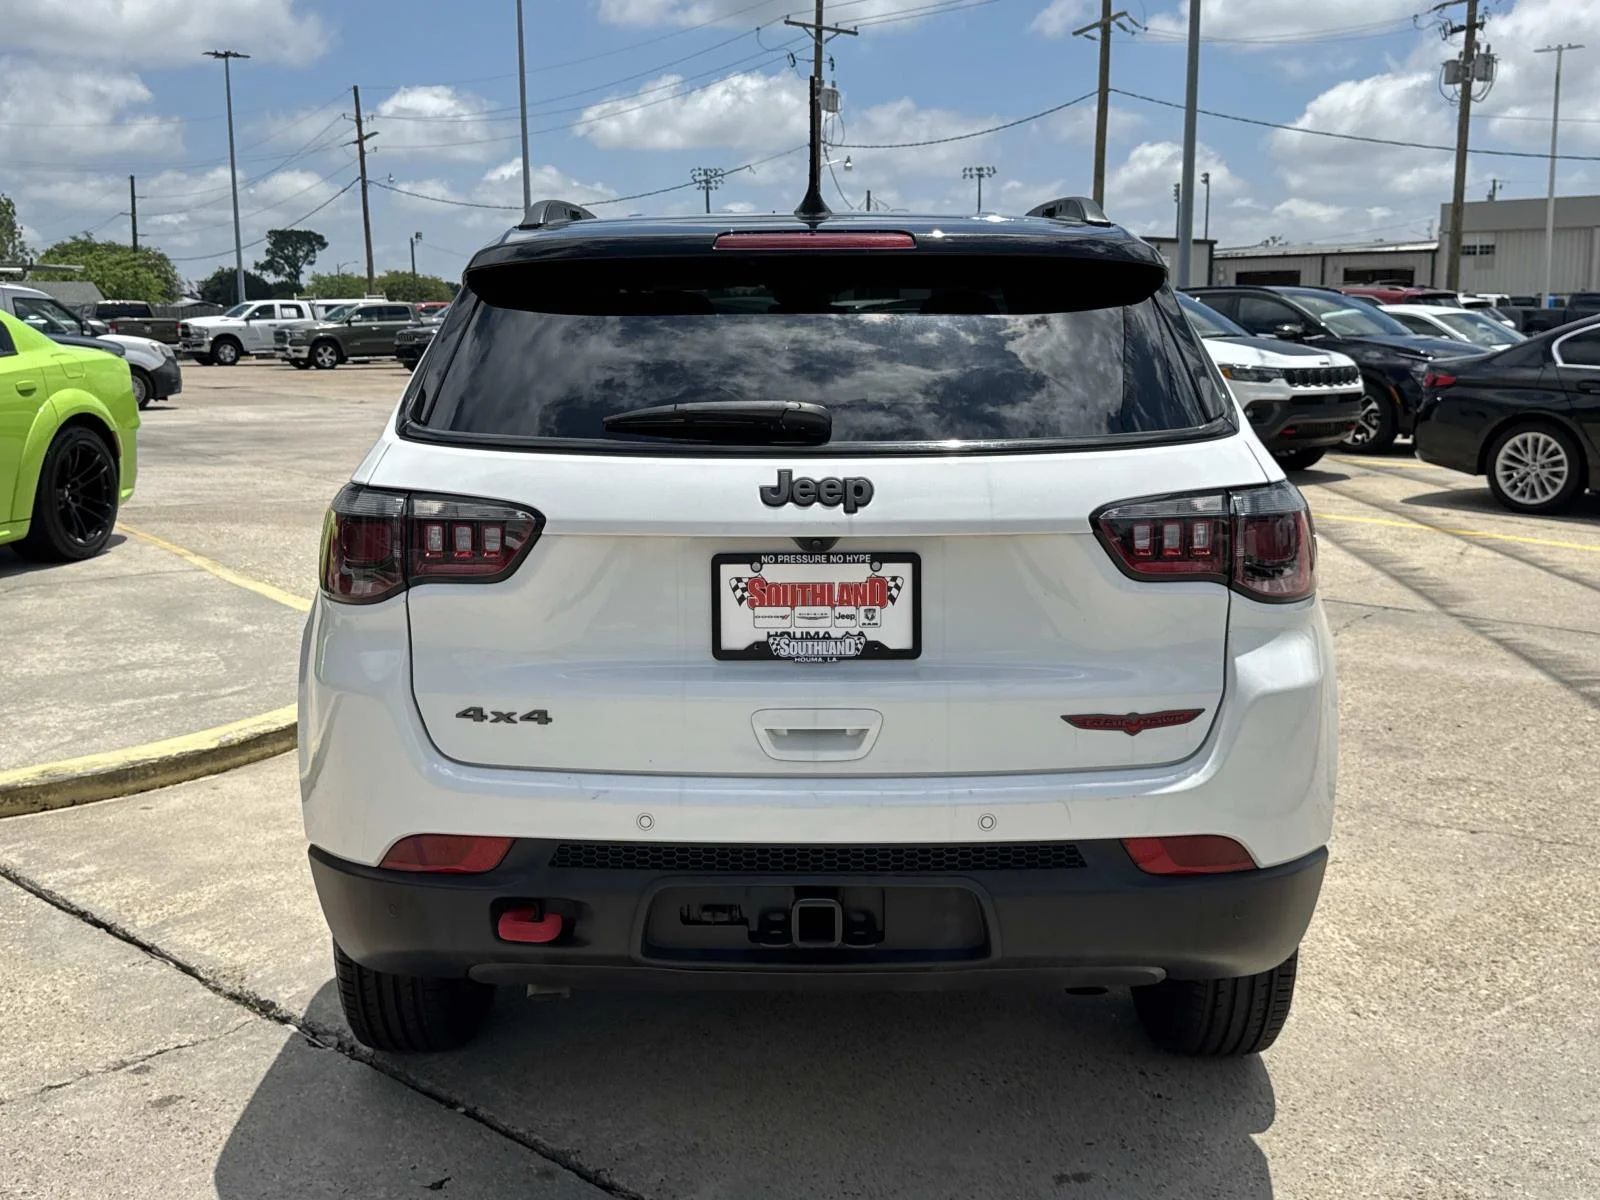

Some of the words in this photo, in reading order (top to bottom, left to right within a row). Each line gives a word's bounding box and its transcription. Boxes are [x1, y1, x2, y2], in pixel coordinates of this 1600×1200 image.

[759, 469, 874, 514] Jeep
[761, 555, 775, 564] NO
[778, 555, 827, 564] PRESSURE
[830, 555, 845, 563] NO
[847, 554, 871, 563] HYPE
[748, 577, 888, 607] SOUTHLAND
[835, 612, 856, 621] Jeep
[779, 638, 856, 655] SOUTHLAND
[456, 706, 553, 725] 4x4
